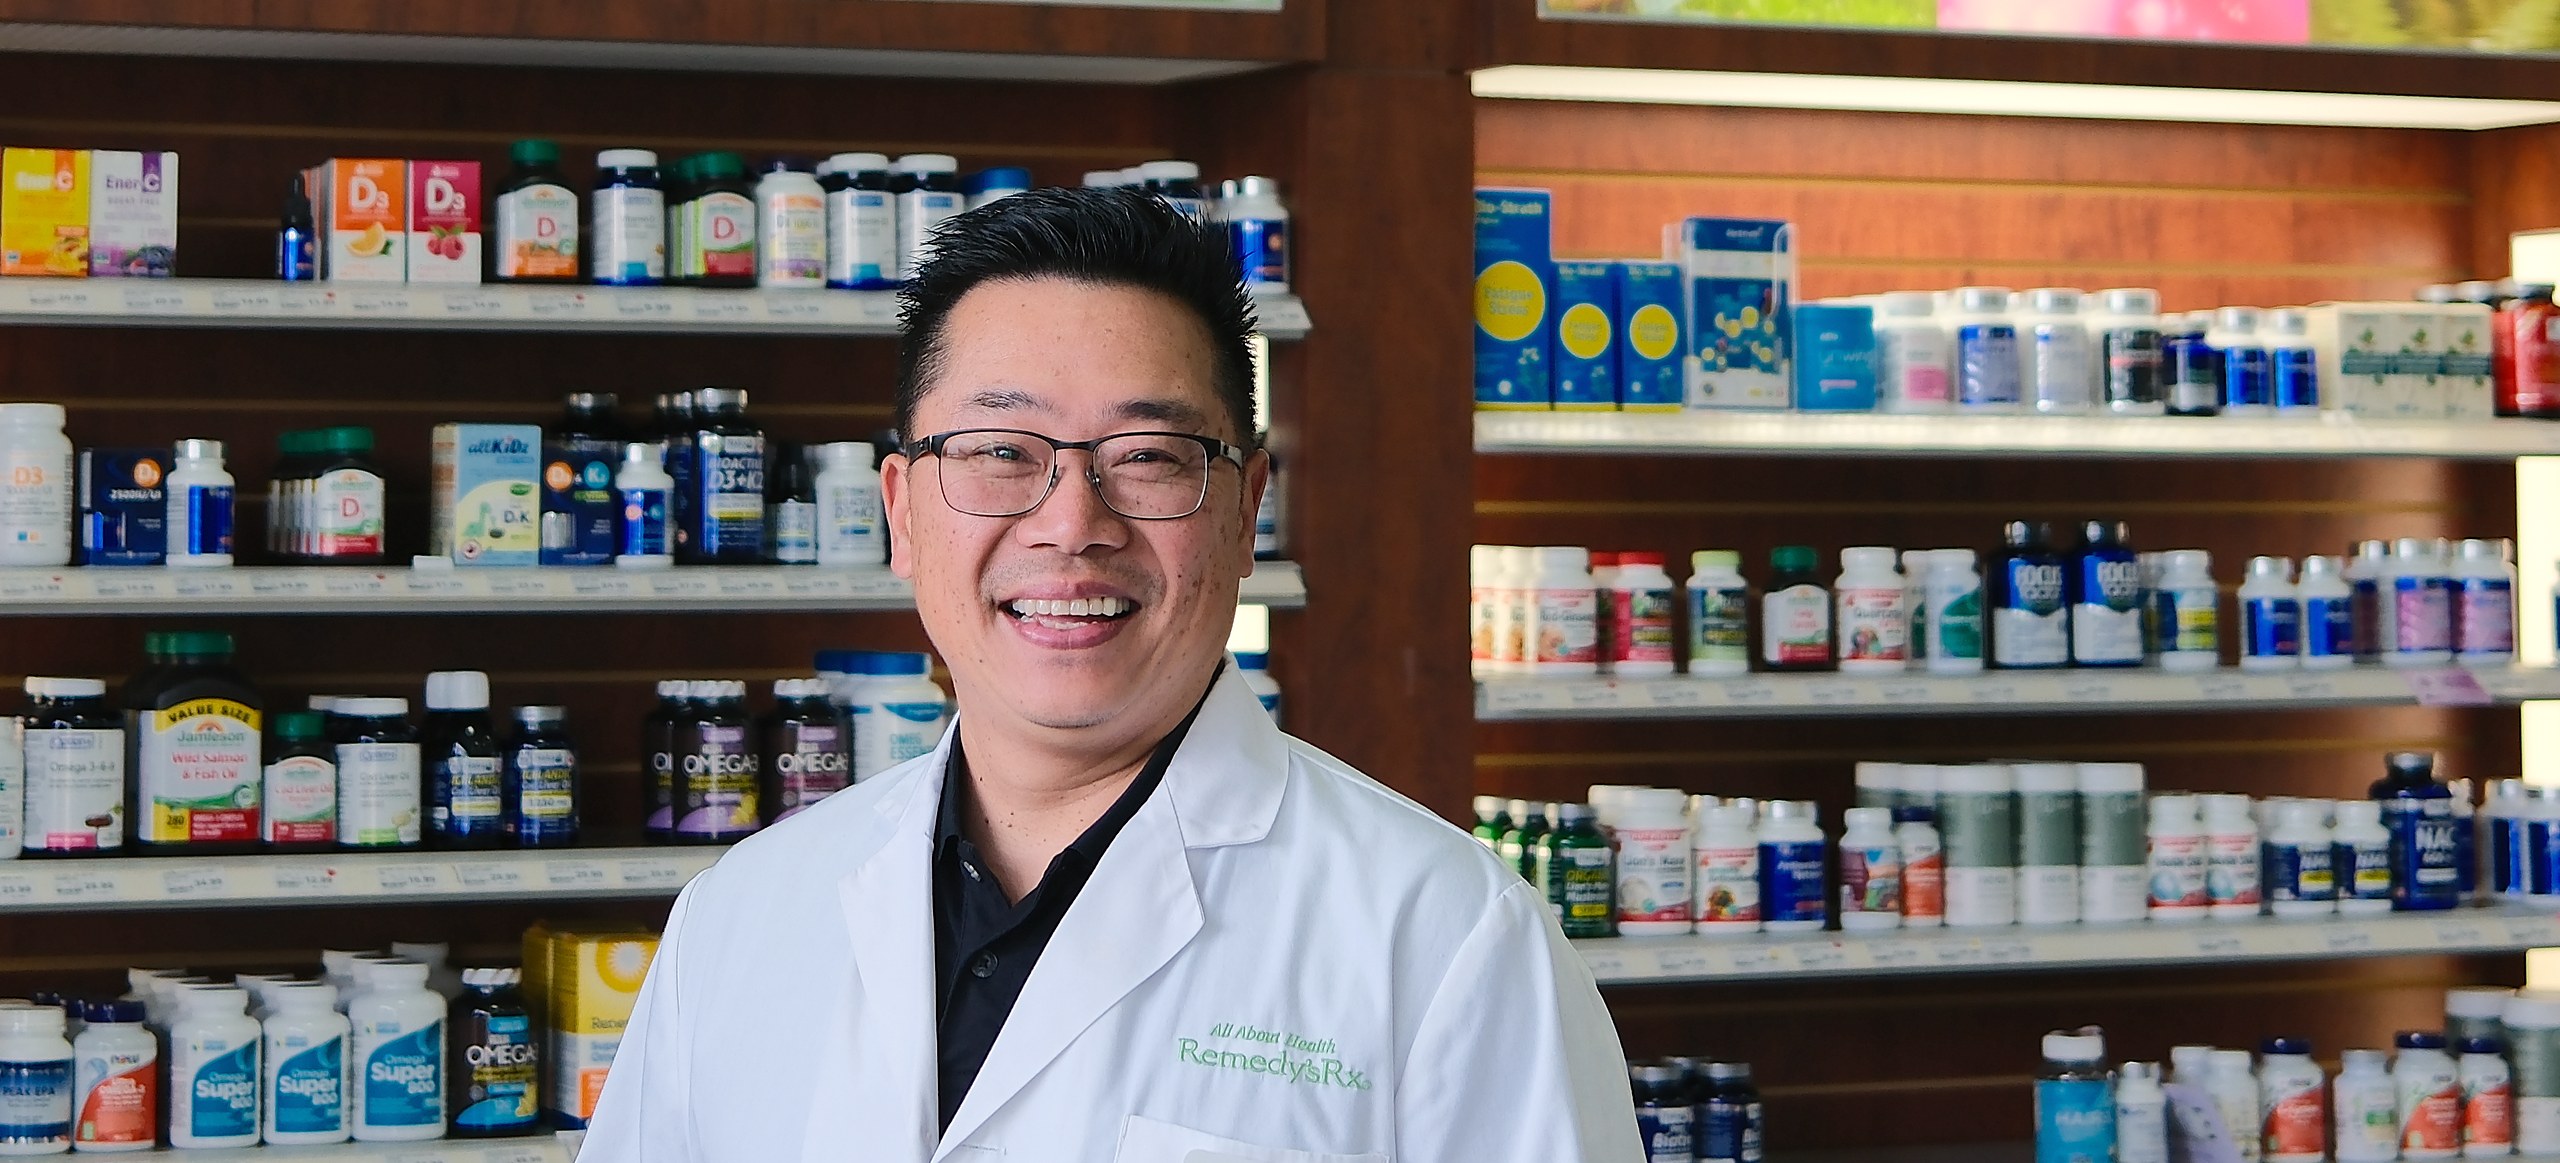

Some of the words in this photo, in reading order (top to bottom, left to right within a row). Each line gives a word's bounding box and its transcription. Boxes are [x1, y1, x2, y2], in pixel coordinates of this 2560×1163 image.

[350, 176, 390, 210] D3
[426, 177, 466, 211] D3
[168, 704, 214, 723] VALUE
[221, 705, 251, 724] SIZE
[1210, 1022, 1234, 1039] All
[1235, 1026, 1281, 1044] About
[1283, 1032, 1336, 1053] Health
[385, 1054, 425, 1066] Omega
[209, 1071, 246, 1083] Omega
[291, 1069, 329, 1079] Omega
[370, 1062, 435, 1084] Super
[196, 1080, 254, 1100] Super
[279, 1075, 338, 1098] Super
